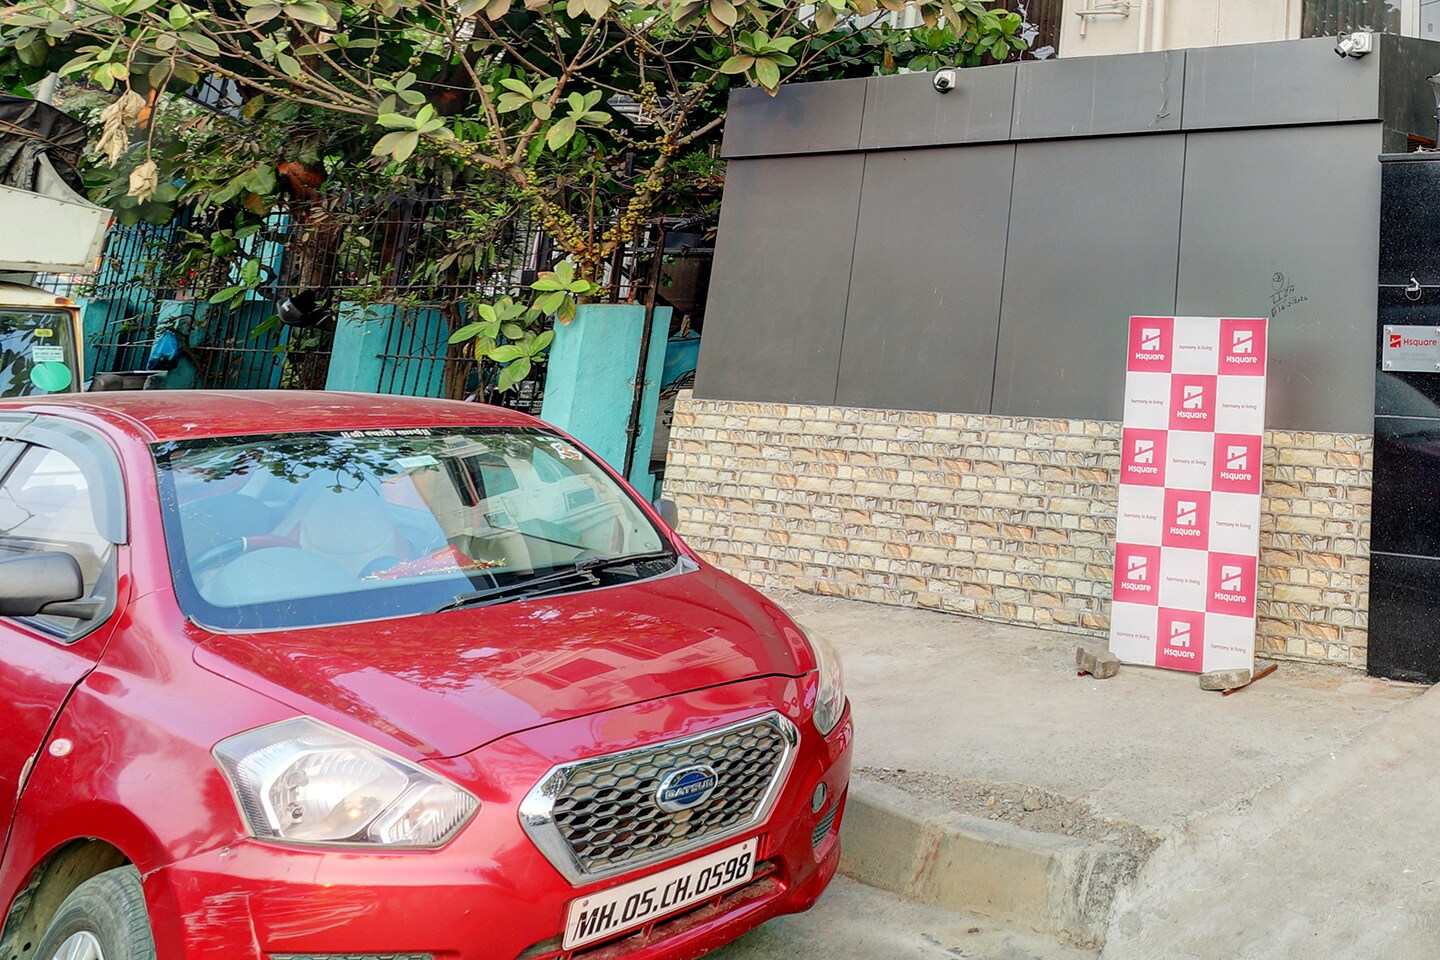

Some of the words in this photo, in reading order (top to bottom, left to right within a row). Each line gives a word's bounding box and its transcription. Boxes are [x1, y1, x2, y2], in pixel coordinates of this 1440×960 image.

[1403, 338, 1438, 347] Hsquare
[1136, 353, 1164, 361] Hsquare
[1226, 356, 1257, 364] Hsquare
[1177, 411, 1207, 419] Hsquare
[1128, 465, 1157, 474] Hsquare
[1221, 471, 1251, 481] Hsquare
[1170, 527, 1201, 536] Hsquare
[1121, 581, 1151, 592] Hsquare
[1189, 578, 1200, 586] living
[1215, 592, 1246, 602] Hsquare
[1164, 648, 1195, 659] Hsquare
[665, 777, 714, 801] DATSUN
[573, 852, 751, 941] MH.05.CH.0598
